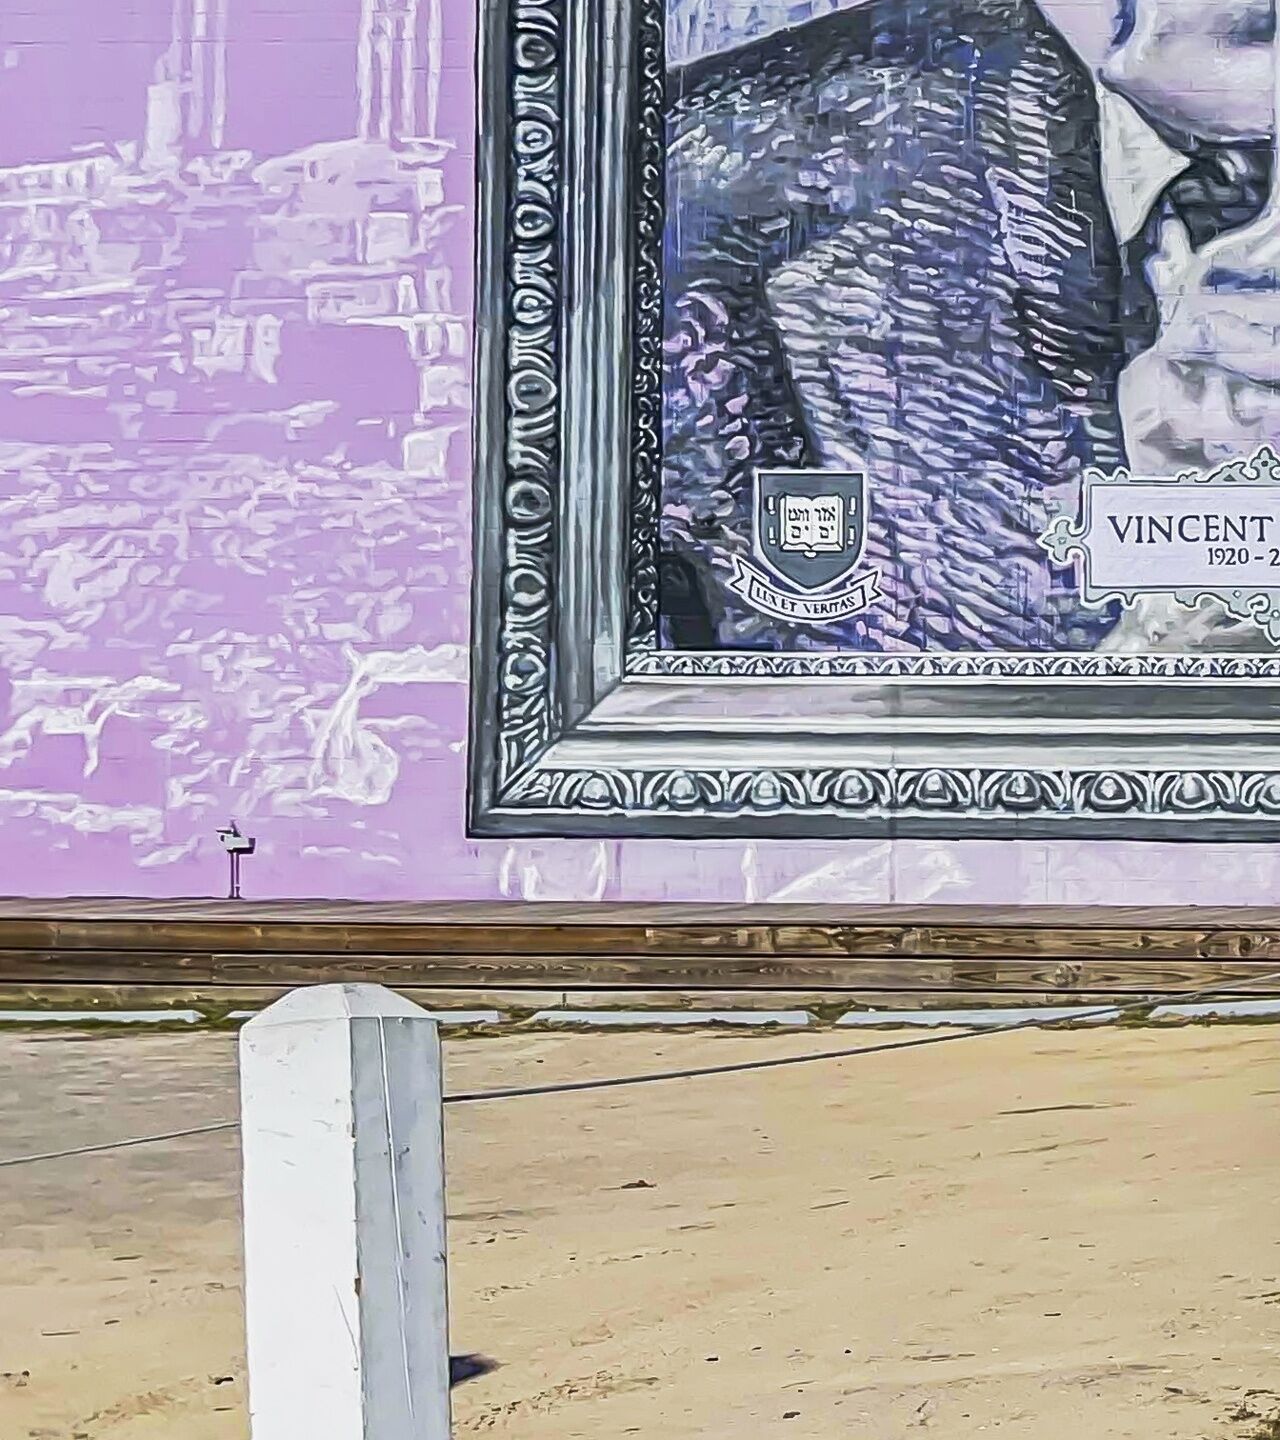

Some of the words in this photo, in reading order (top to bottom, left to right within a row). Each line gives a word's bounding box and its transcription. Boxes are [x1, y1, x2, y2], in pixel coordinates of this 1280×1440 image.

[1107, 514, 1274, 543] VINCENT
[1207, 547, 1249, 566] 1920
[756, 587, 777, 606] LUX
[781, 598, 797, 612] ET
[803, 596, 855, 614] VERITAS
